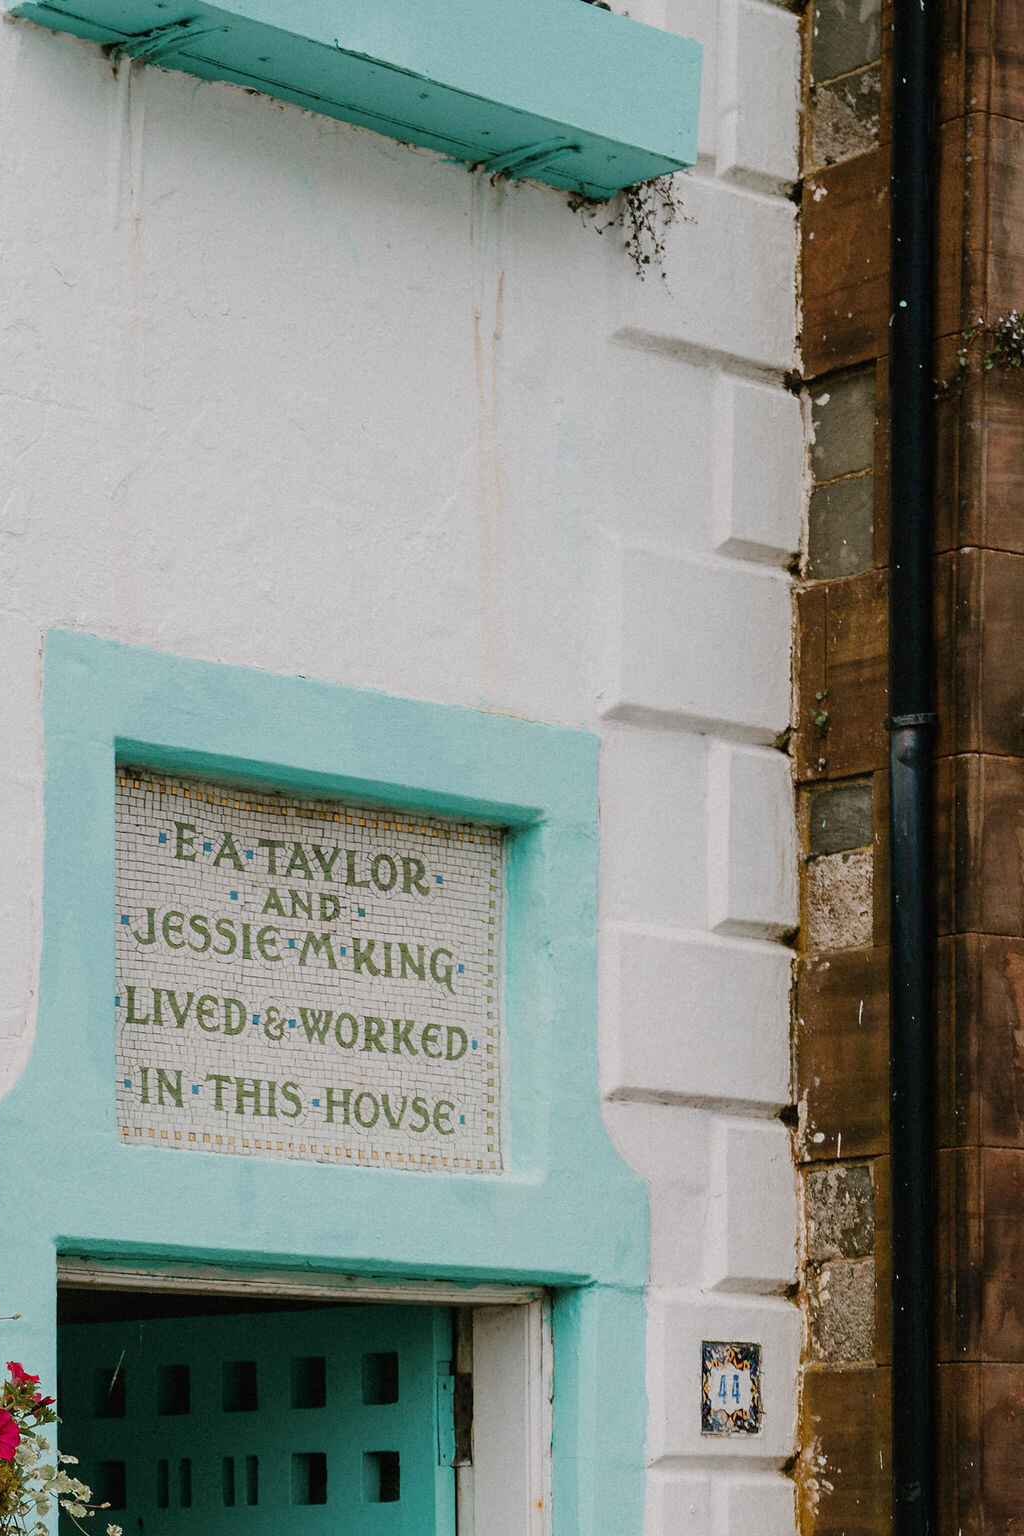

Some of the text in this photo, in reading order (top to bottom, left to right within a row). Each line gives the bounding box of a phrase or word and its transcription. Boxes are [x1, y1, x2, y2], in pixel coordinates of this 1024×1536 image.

[175, 821, 431, 896] E A TAYLOR
[261, 887, 341, 922] AND
[131, 907, 456, 996] JESSIE M KING
[125, 985, 469, 1061] LIVED & WORKED
[139, 1065, 184, 1108] IN
[204, 1073, 303, 1118] THIS
[717, 1374, 740, 1404] 44
